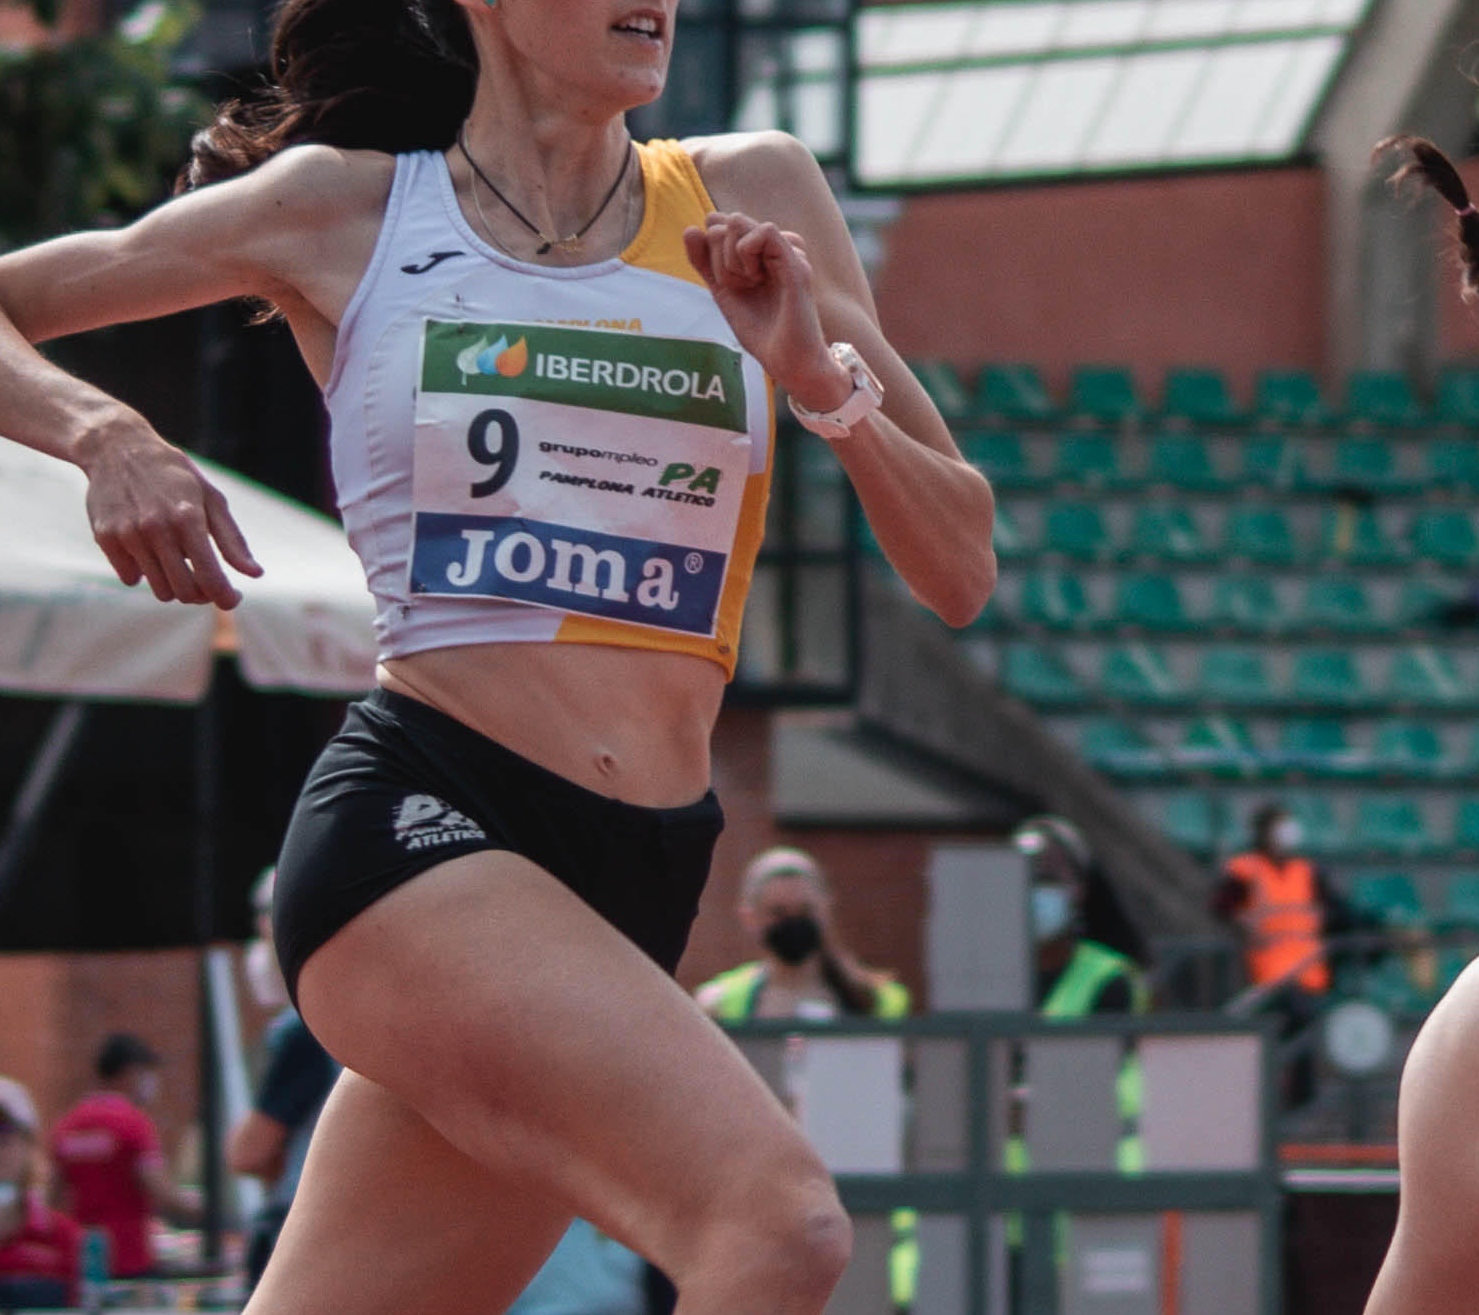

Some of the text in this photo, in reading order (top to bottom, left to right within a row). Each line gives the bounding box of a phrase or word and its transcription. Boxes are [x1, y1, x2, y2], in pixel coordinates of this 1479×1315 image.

[535, 353, 726, 403] IBERDROLA
[467, 408, 520, 498] 9
[539, 470, 716, 507] PAMPLONA ATLETICO
[658, 462, 722, 494] PA
